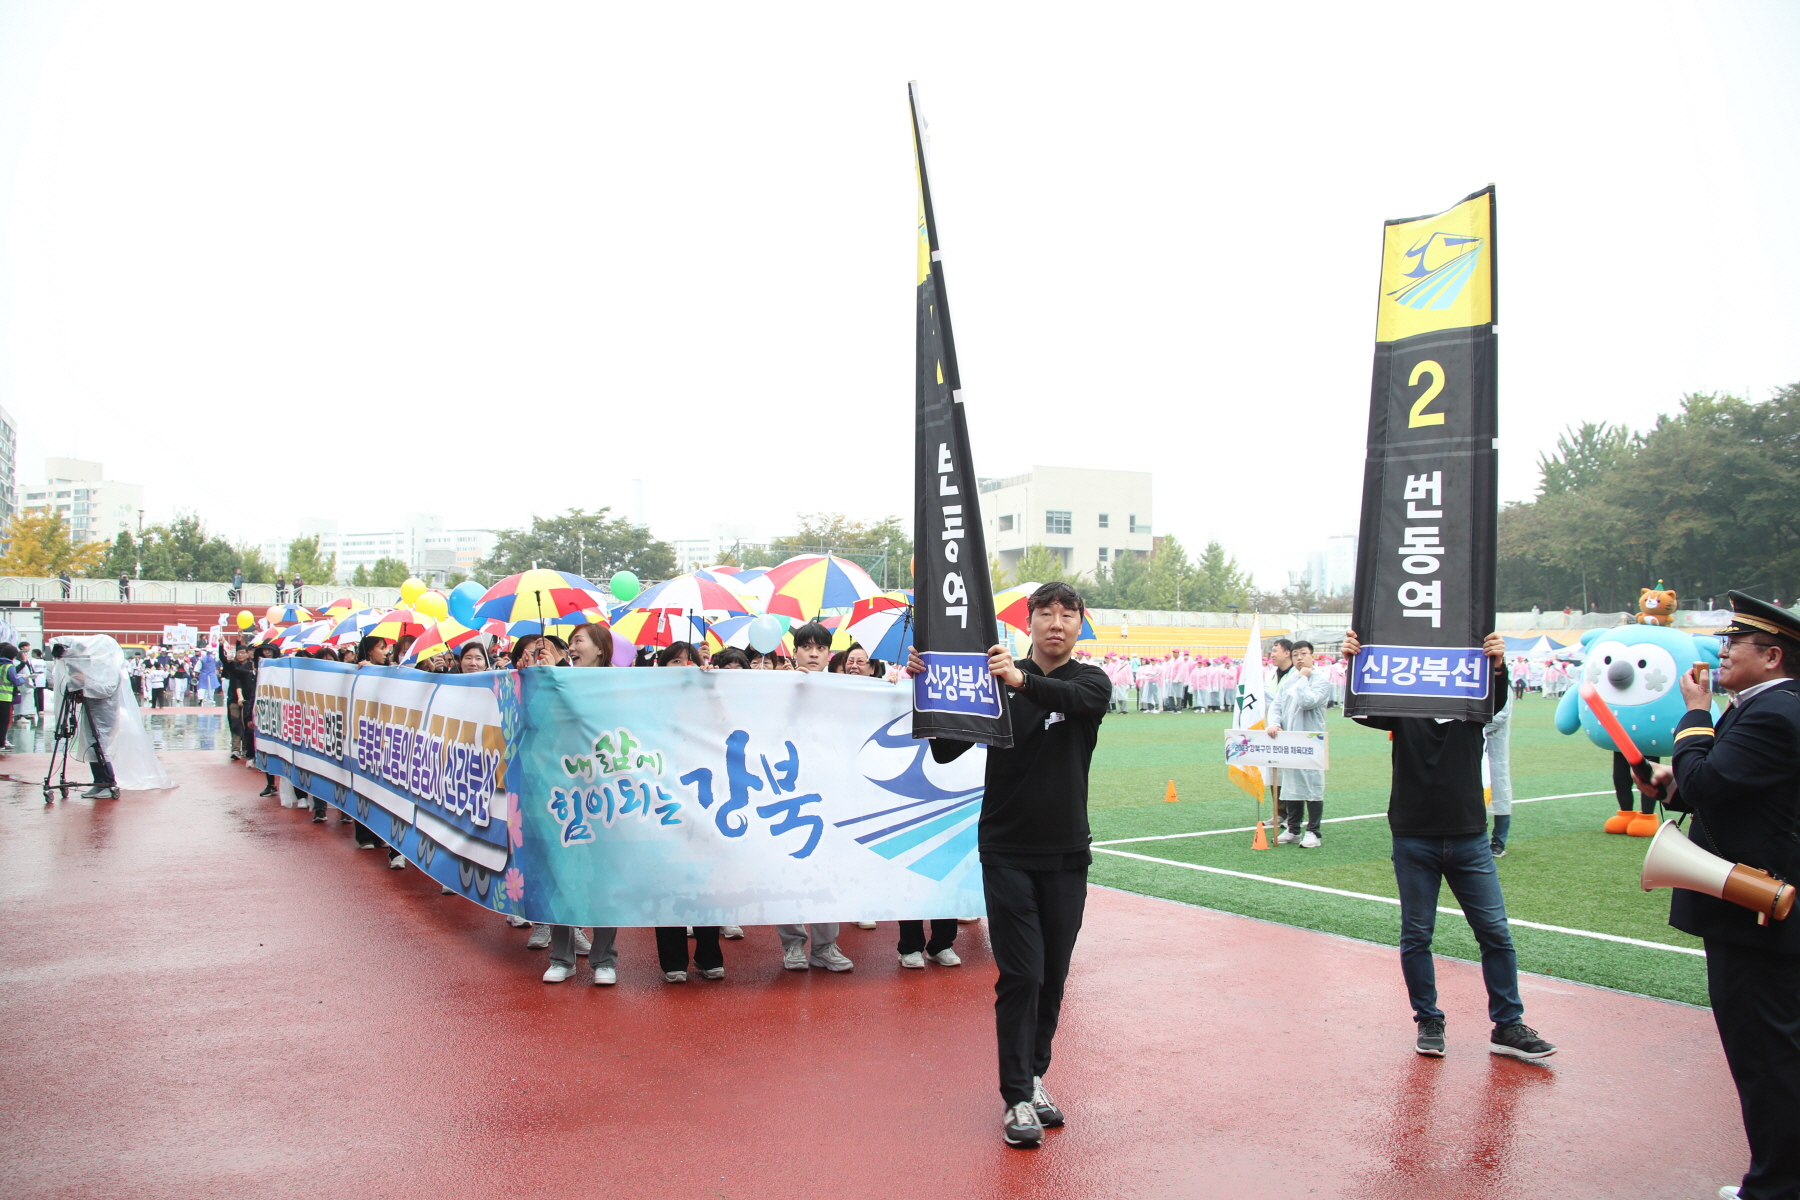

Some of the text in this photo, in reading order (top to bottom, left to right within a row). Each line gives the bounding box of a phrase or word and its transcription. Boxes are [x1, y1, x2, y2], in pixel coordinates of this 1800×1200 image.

[1407, 359, 1446, 429] 2
[1397, 470, 1446, 628] 번동역
[924, 664, 995, 704] 신강북선
[1361, 654, 1482, 688] 신강북선
[283, 702, 302, 745] 행복을
[303, 703, 325, 753] 누리는
[325, 708, 343, 760] 번3동
[1235, 744, 1314, 756] 2023 강북구민 한마음 체육대회
[358, 717, 499, 826] 동북부 교통의 중심지 신강북선
[680, 729, 824, 859] 강북
